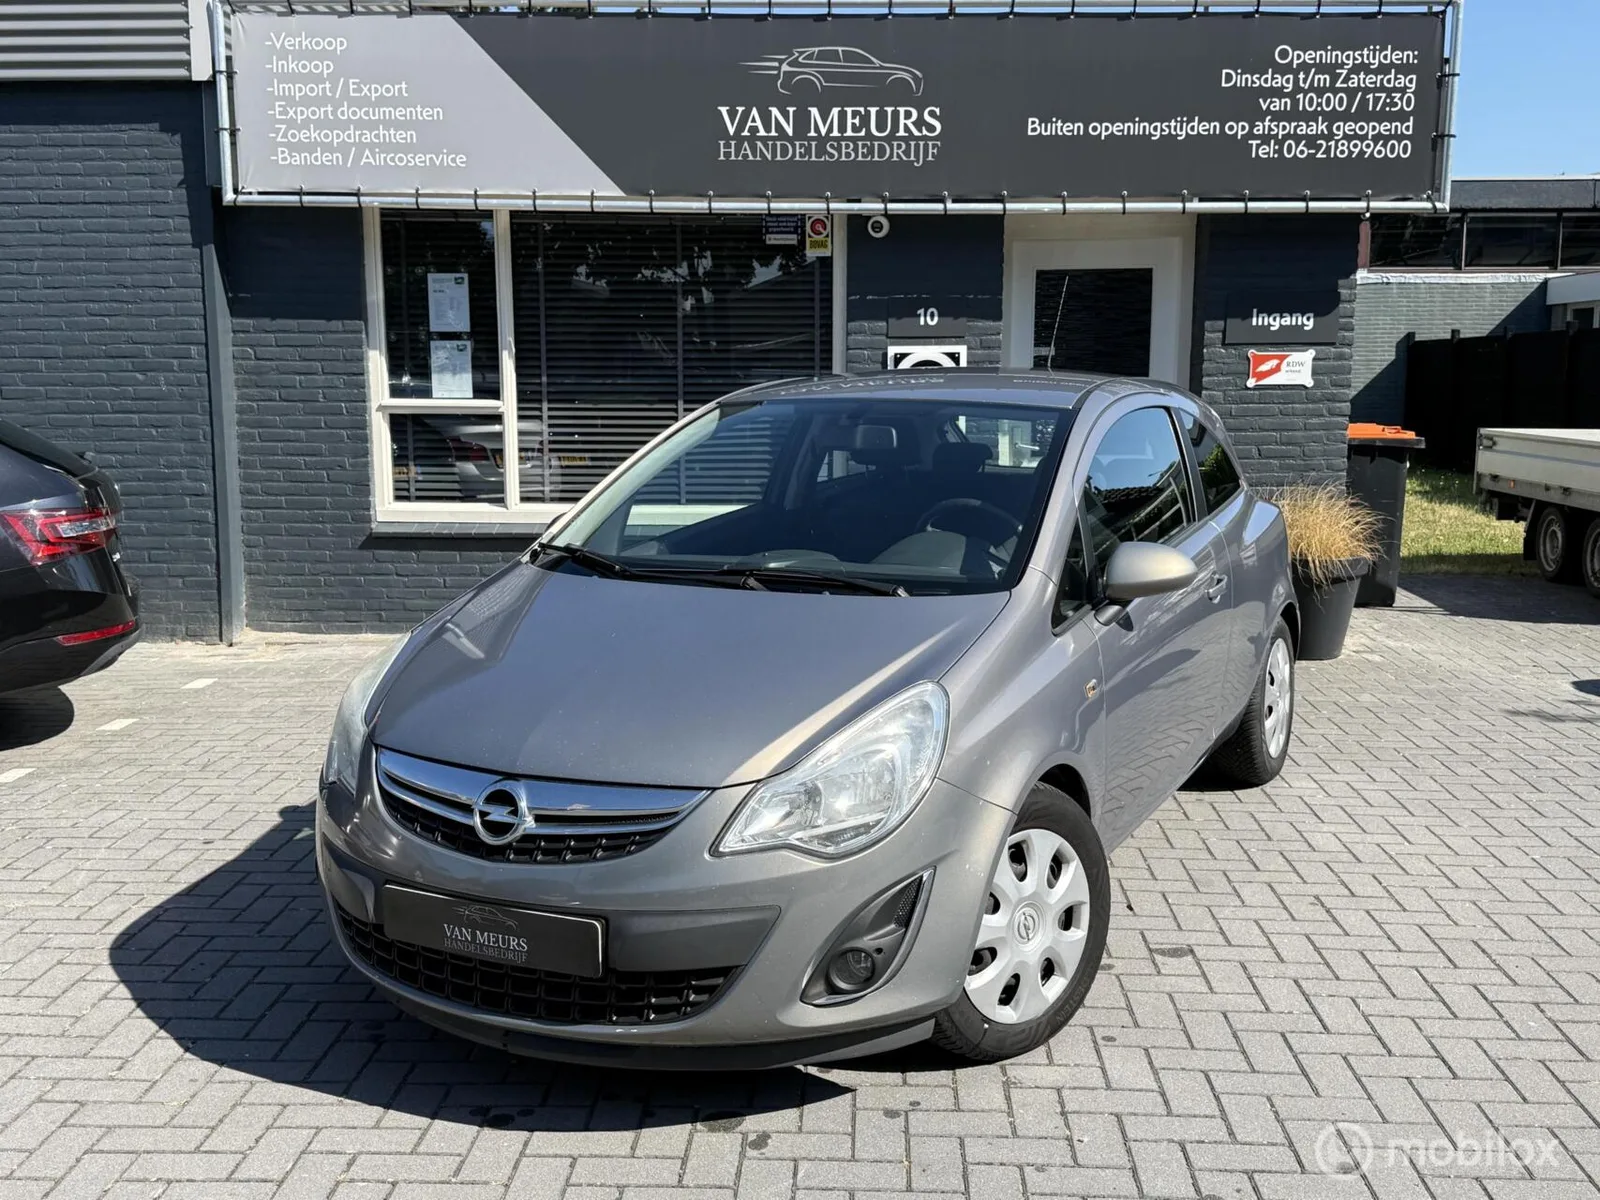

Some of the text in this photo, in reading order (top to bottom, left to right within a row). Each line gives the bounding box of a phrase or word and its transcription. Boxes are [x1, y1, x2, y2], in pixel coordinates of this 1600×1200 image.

[265, 32, 347, 54] -Verkoop
[265, 55, 333, 77] -Inkoop
[1275, 45, 1418, 68] Openingstijden:
[266, 78, 332, 101] -Import
[349, 79, 408, 100] Export
[1221, 69, 1416, 92] Dinsdag t/m Zaterdag
[267, 101, 443, 123] -Export documenten
[1259, 98, 1290, 111] van
[1297, 93, 1347, 111] 10:00
[1366, 93, 1415, 111] 17:30
[717, 106, 942, 136] VAN MEURS
[1027, 117, 1413, 140] Buiten openingstijden op afspraak geopend
[269, 124, 416, 146] -Zoekopdrachten
[270, 148, 342, 166] -Banden
[360, 148, 467, 167] Aircoservice
[718, 141, 941, 166] HANDELSBEDRIJF
[1248, 140, 1411, 159] Tel: 06-21899600
[917, 307, 939, 326] 10
[1251, 308, 1314, 331] Ingang
[1286, 360, 1306, 368] RDW
[443, 924, 528, 951] VAN MEURS
[444, 938, 528, 963] HANDELSBEDRIJF
